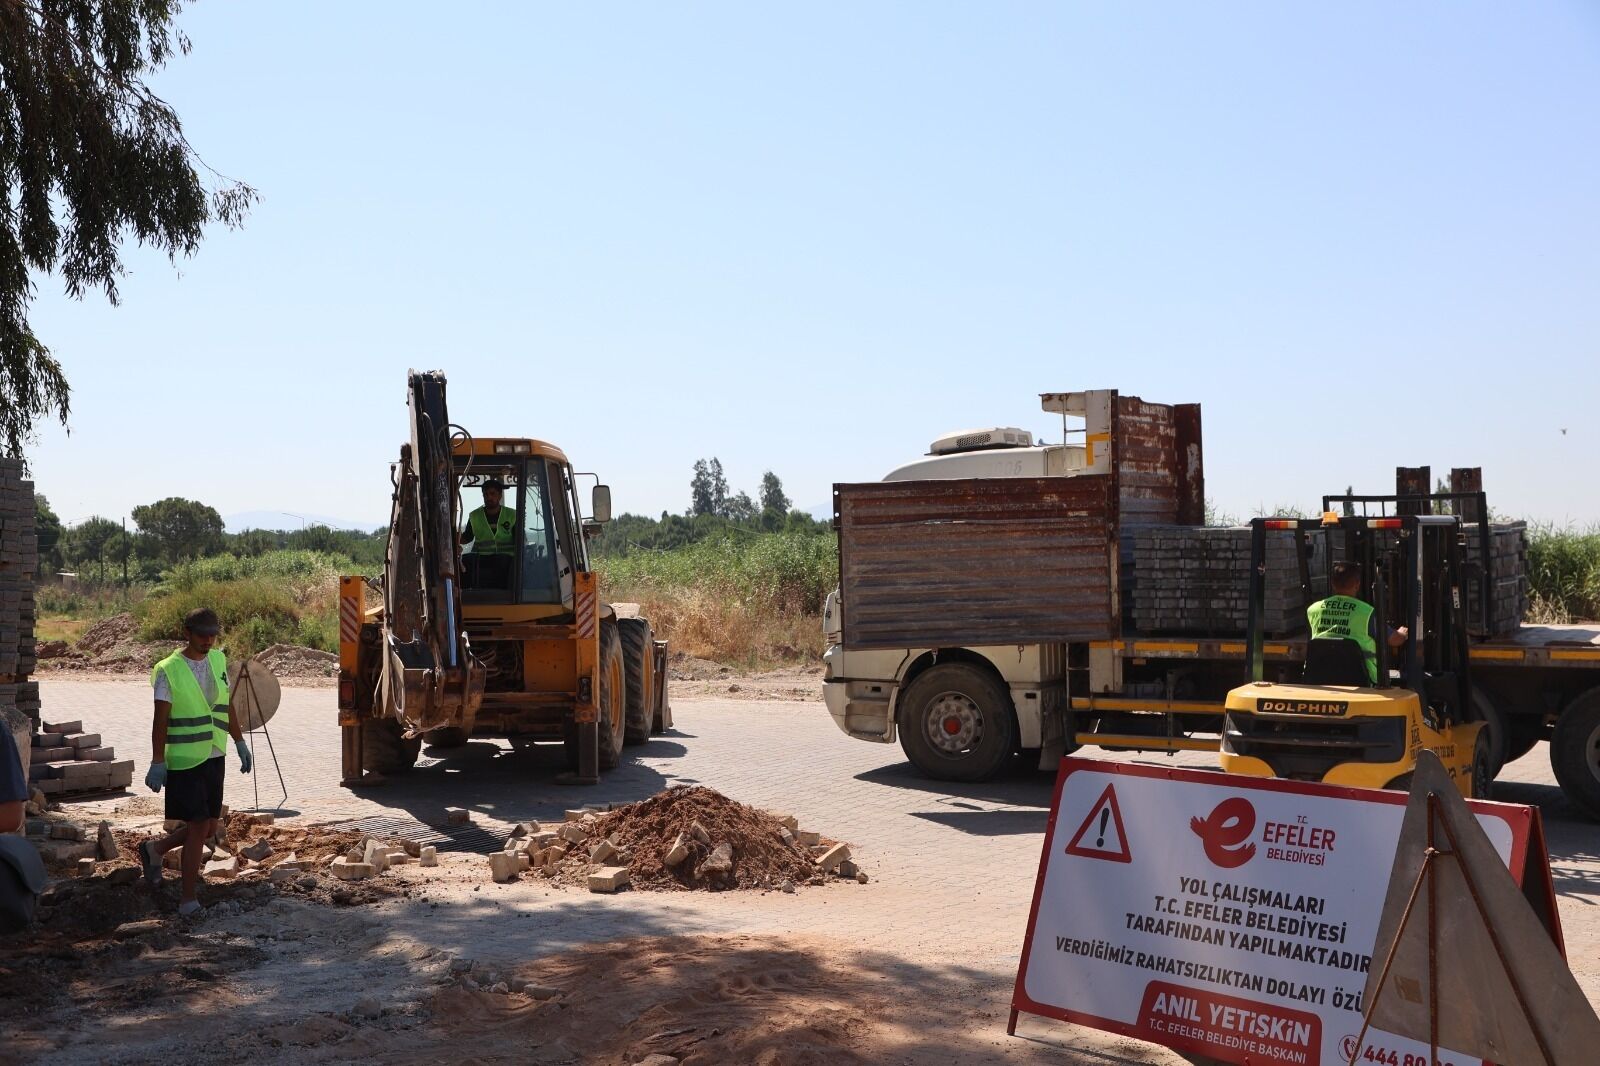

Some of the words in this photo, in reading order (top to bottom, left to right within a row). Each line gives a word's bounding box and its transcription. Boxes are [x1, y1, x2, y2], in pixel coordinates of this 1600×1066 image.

[1263, 702, 1340, 713] DOLPHIN
[1263, 821, 1336, 851] EFELER
[1266, 848, 1326, 867] BELEDİYESİ
[1180, 876, 1209, 897] YOL
[1212, 882, 1325, 915] ÇALIŞMALARI
[1155, 895, 1181, 915] T.C.
[1183, 900, 1243, 926] EFELER
[1245, 910, 1348, 944] BELEDİYESİ
[1126, 912, 1226, 947] TARAFINDAN
[1229, 930, 1372, 974] YAPILMAKTADIR
[1056, 935, 1134, 966] VERDİĞİMİZ
[1135, 952, 1264, 993] RAHATSIZLIKTAN
[1266, 977, 1326, 1005] DOLAYI
[1152, 992, 1202, 1023] ANIL
[1150, 1018, 1166, 1032] T.C.
[1167, 1022, 1205, 1040] EFELER
[1206, 1032, 1257, 1052] BELEDİYE
[1258, 1043, 1307, 1065] BAŞKANI
[1363, 1044, 1399, 1066] 444
